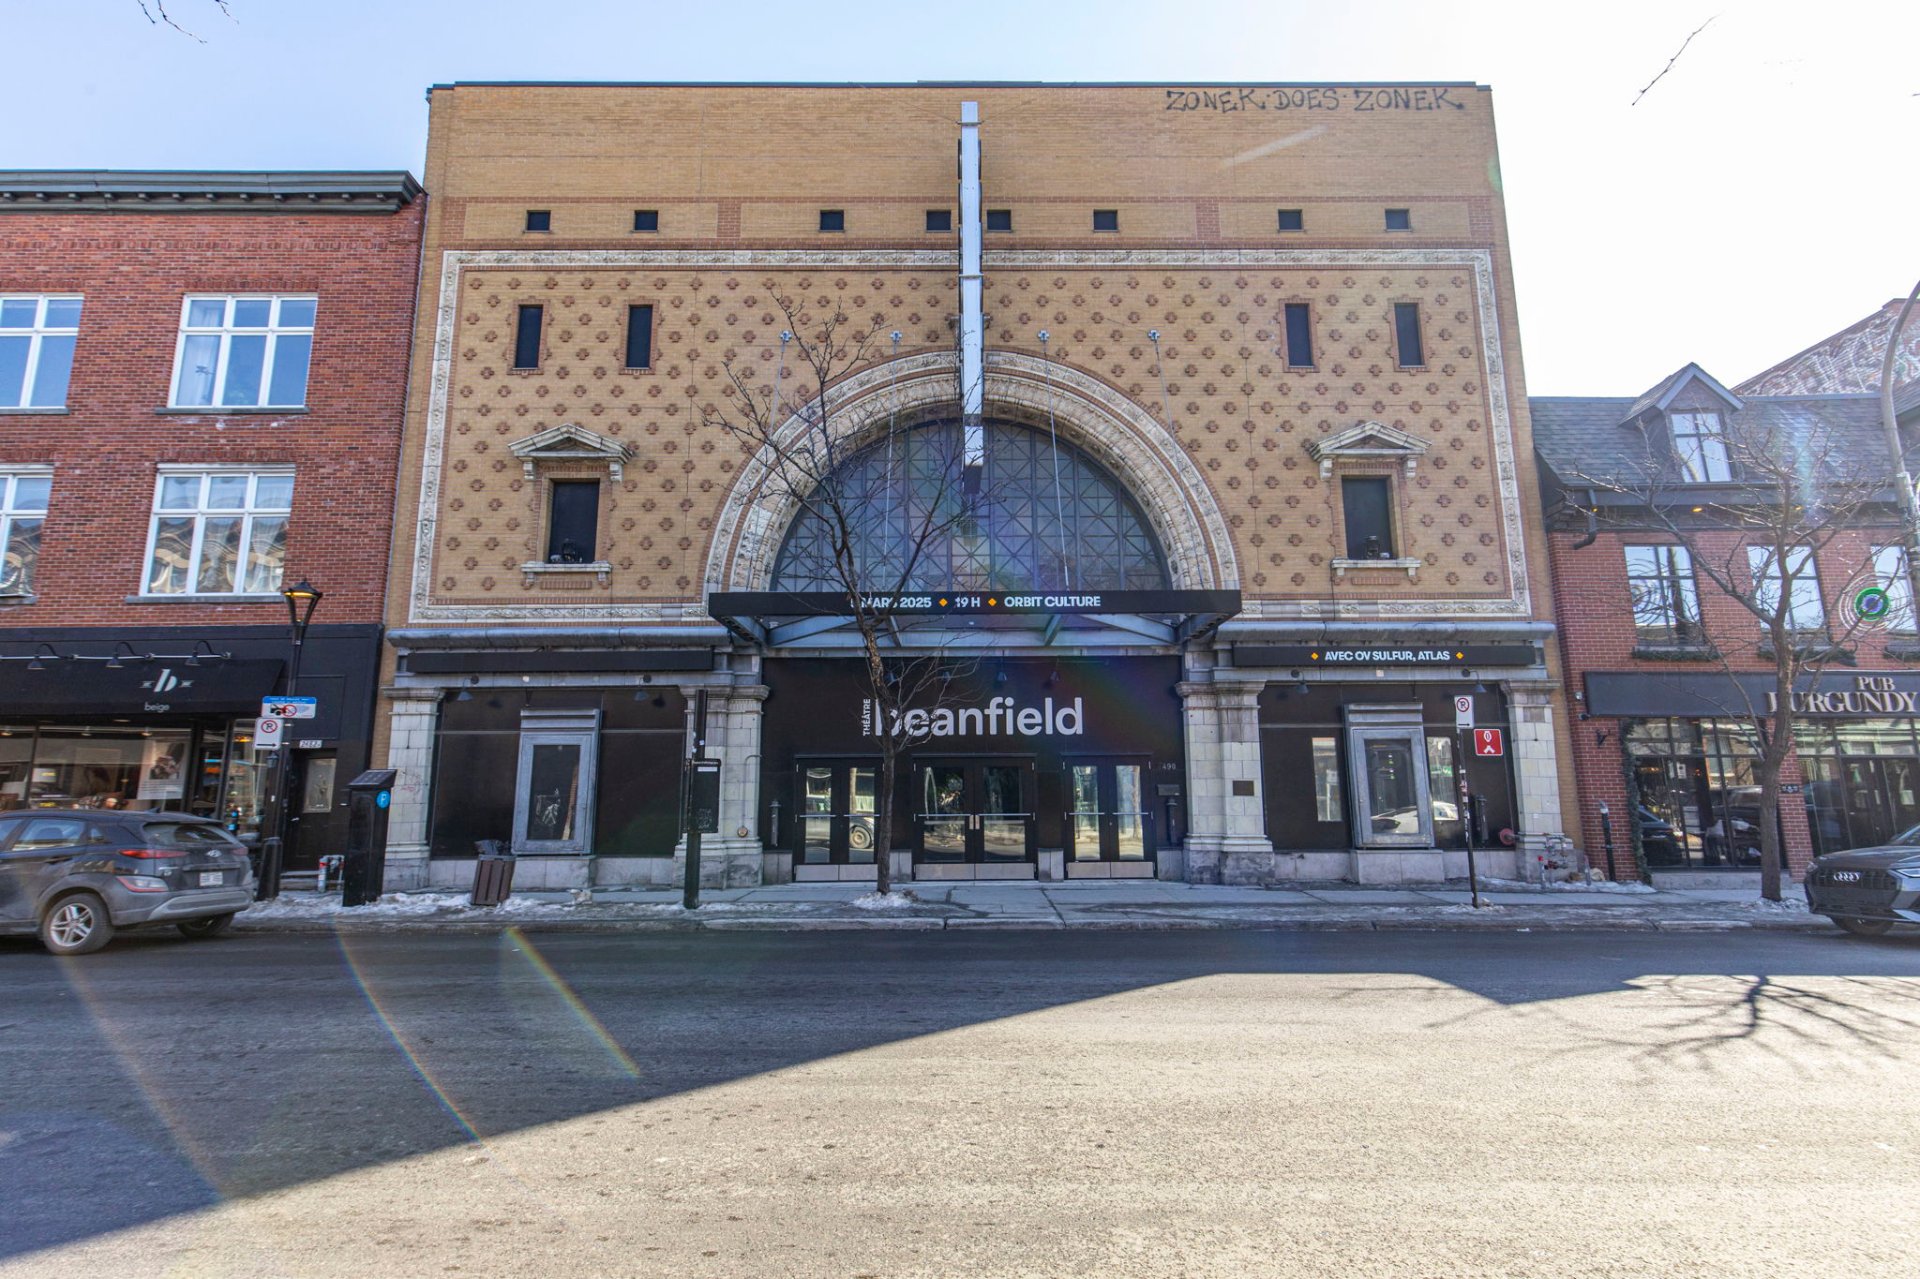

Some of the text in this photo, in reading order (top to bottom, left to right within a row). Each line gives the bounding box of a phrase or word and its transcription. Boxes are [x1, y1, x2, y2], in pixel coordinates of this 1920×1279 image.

[1166, 88, 1464, 113] ZONEK DOES ZONEK
[900, 597, 932, 608] 2025
[955, 597, 968, 608] 19
[971, 597, 981, 608] H
[1004, 596, 1043, 608] ORBIT
[1044, 596, 1101, 608] CULTURE
[1325, 650, 1450, 661] AVEC OV SULFUR, ATLAS
[1857, 676, 1896, 690] PUB
[144, 701, 170, 713] beige
[875, 696, 1084, 737] beanfield
